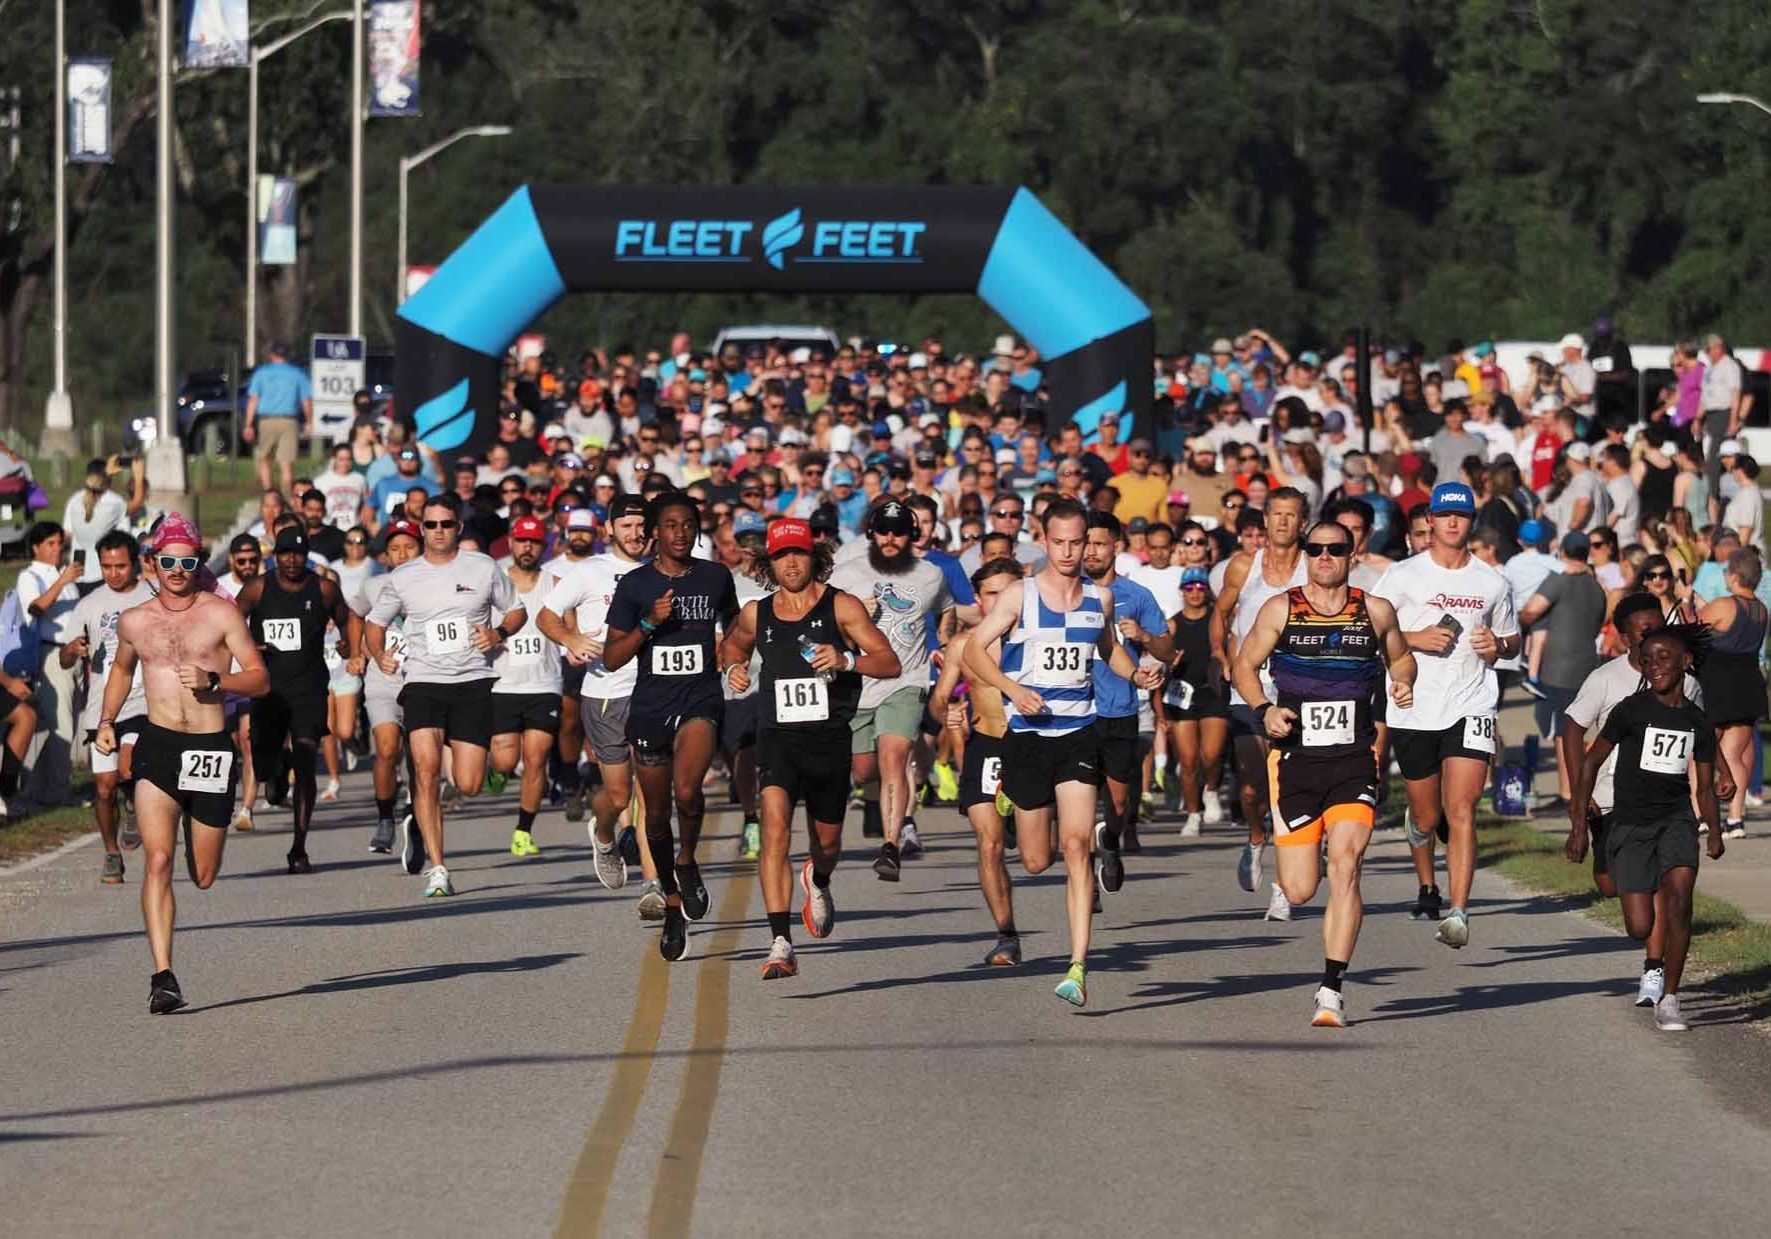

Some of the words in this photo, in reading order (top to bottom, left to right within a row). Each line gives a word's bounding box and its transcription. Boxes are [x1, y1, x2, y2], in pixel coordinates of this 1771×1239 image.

[615, 220, 753, 256] FLEET
[813, 221, 926, 257] FEET
[320, 376, 355, 395] 103
[671, 595, 710, 609] OUTH
[1446, 598, 1484, 609] RAMS
[268, 623, 294, 640] 373
[437, 624, 457, 642] 96
[1289, 635, 1326, 645] FLEET
[1341, 635, 1370, 646] FEET
[515, 636, 541, 655] 519
[661, 650, 696, 672] 193
[1043, 646, 1080, 671] 333
[783, 682, 819, 707] 161
[1311, 705, 1349, 730] 524
[1652, 733, 1688, 760] 571
[188, 754, 223, 779] 251
